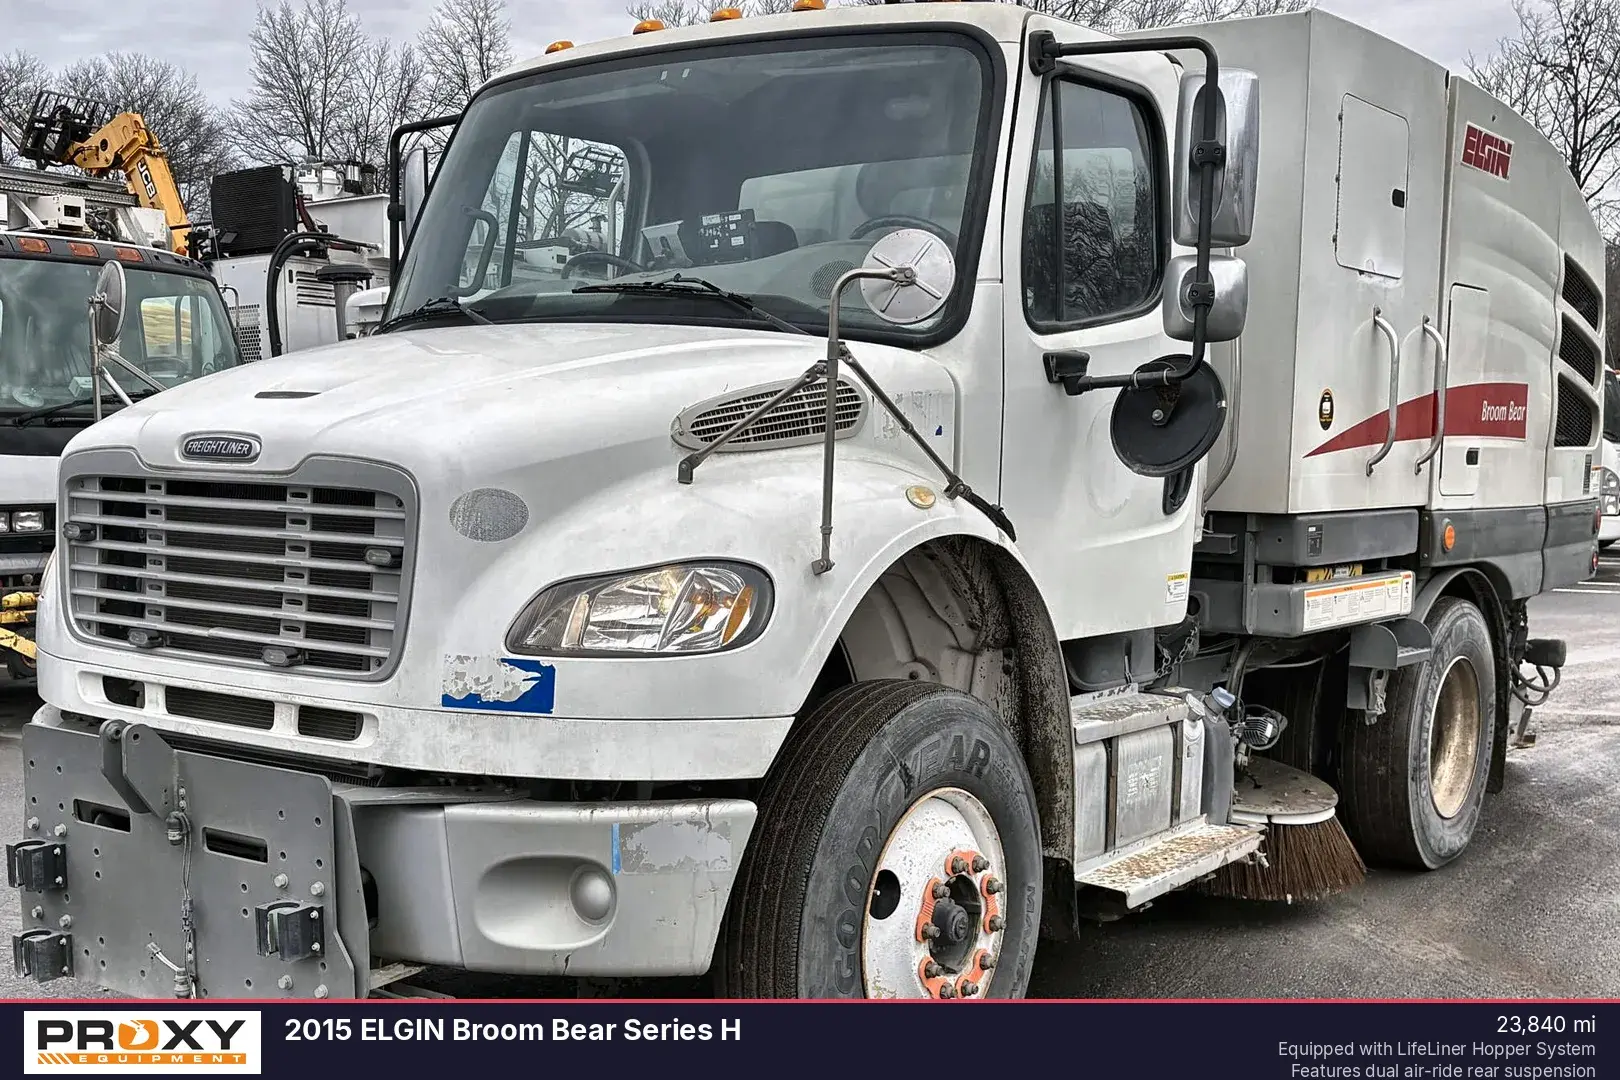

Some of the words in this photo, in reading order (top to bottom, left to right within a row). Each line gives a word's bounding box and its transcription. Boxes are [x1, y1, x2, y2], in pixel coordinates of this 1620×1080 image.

[1461, 124, 1513, 180] ELGIN
[137, 159, 157, 199] JCB
[1481, 400, 1507, 421] Broom
[1508, 400, 1526, 421] Bear
[186, 440, 250, 455] FREIGHTLINER
